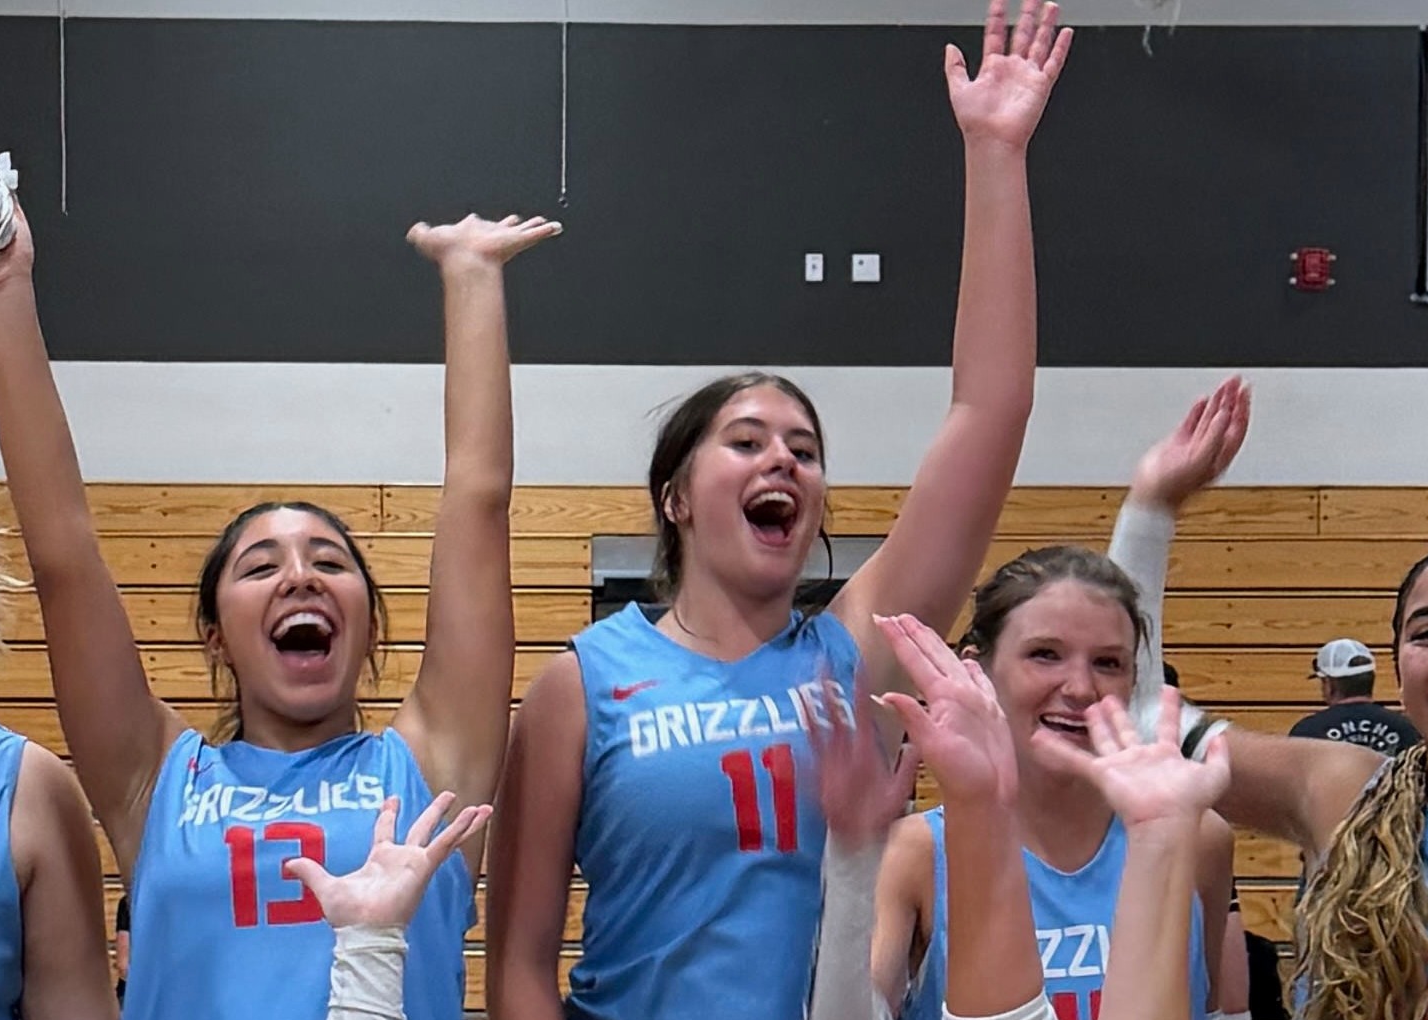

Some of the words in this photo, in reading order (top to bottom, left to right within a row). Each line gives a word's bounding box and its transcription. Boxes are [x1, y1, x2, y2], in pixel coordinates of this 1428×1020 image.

[629, 679, 856, 758] GRIZZLIES
[720, 743, 798, 855] 11
[224, 821, 325, 928] 13
